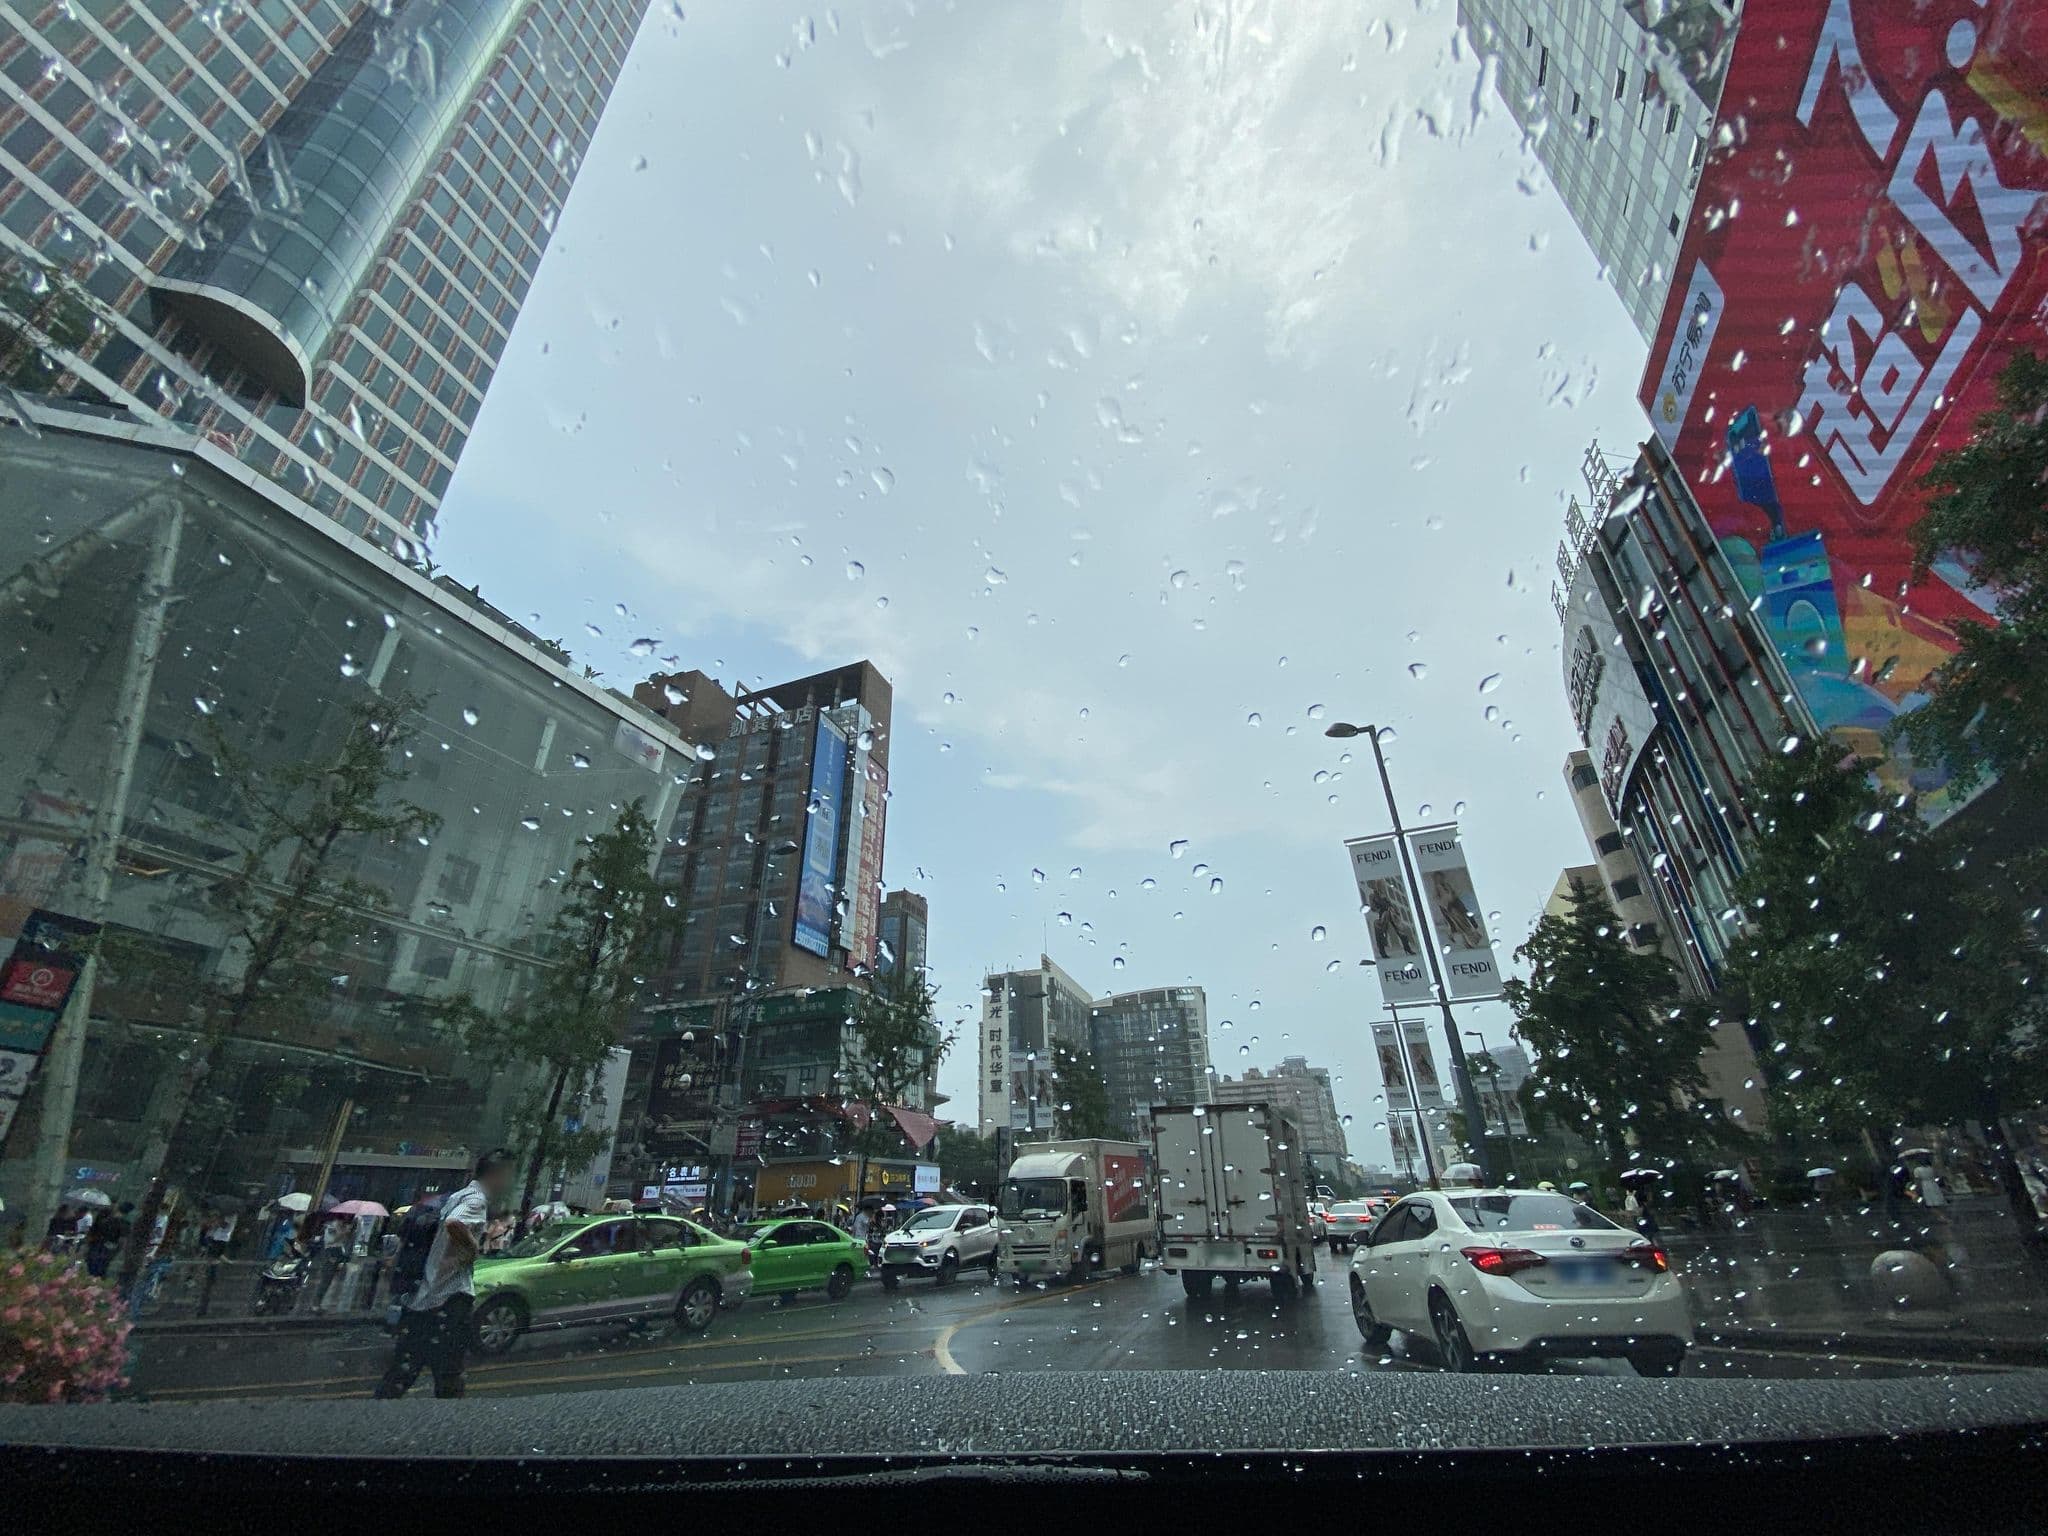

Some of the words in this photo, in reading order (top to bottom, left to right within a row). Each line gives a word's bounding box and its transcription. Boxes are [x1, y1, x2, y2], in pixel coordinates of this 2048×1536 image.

[1419, 840, 1456, 855] FENDI
[1356, 850, 1391, 864] FENDI
[1384, 967, 1422, 982] FENDI
[1452, 961, 1491, 975] FENDI
